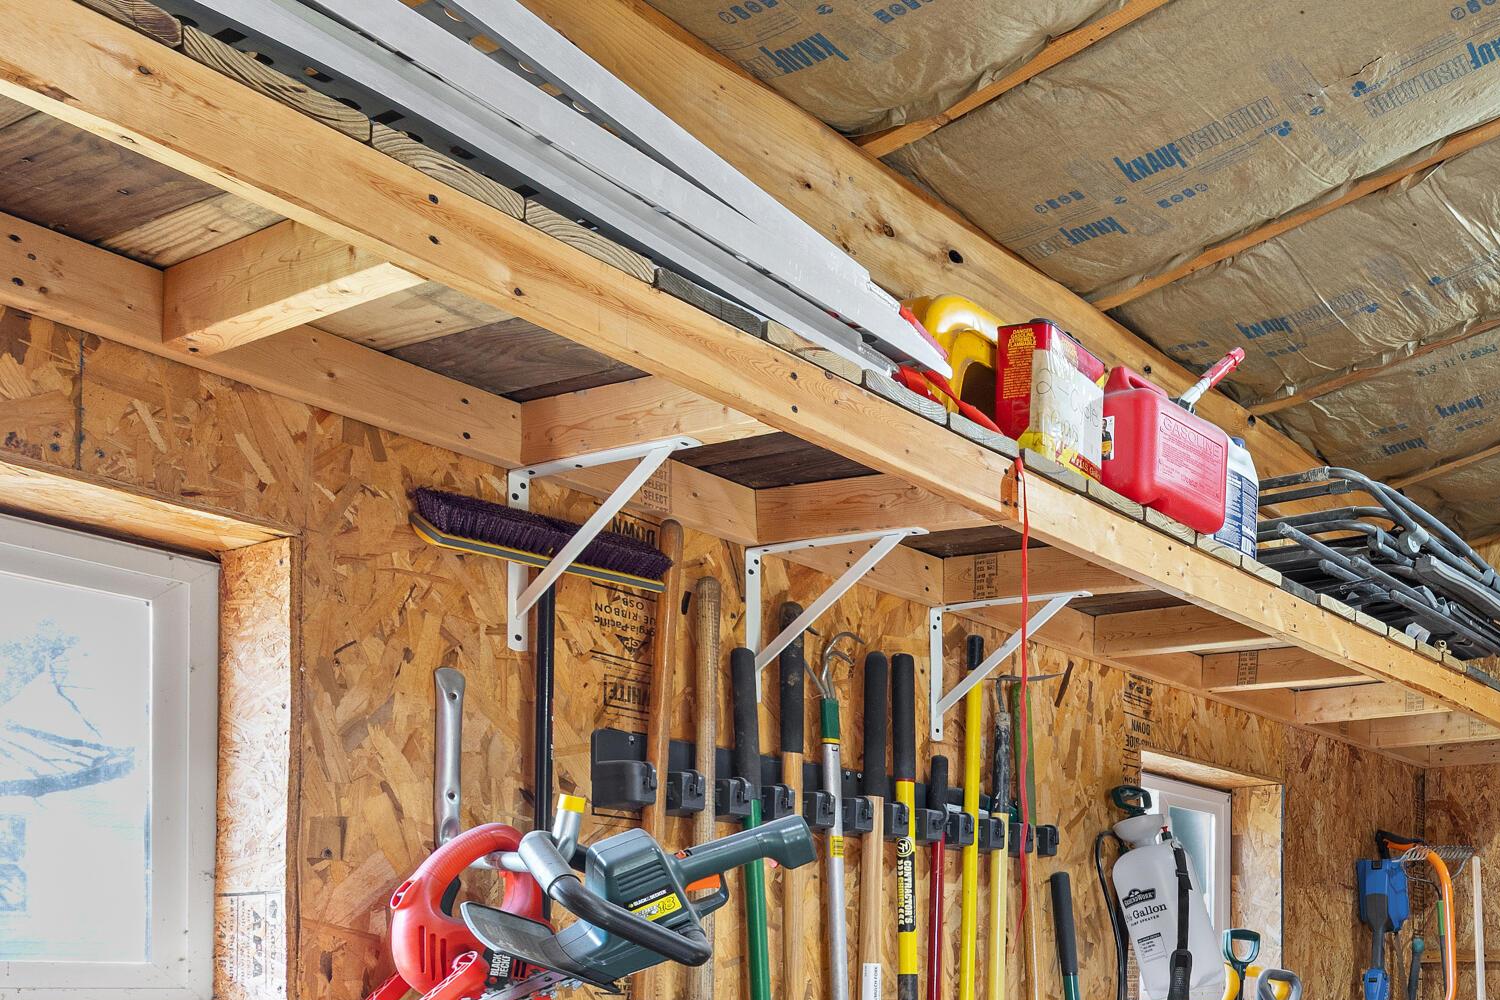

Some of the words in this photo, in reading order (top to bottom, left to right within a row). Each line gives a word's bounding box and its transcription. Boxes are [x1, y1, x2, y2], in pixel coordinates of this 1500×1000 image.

[1113, 142, 1188, 183] KNAUF
[1163, 417, 1220, 457] GASOLINE
[644, 490, 668, 505] SELECT
[594, 602, 638, 622] RIBBON
[904, 860, 913, 924] CONTRACTOR'S
[1133, 903, 1167, 920] Gallon
